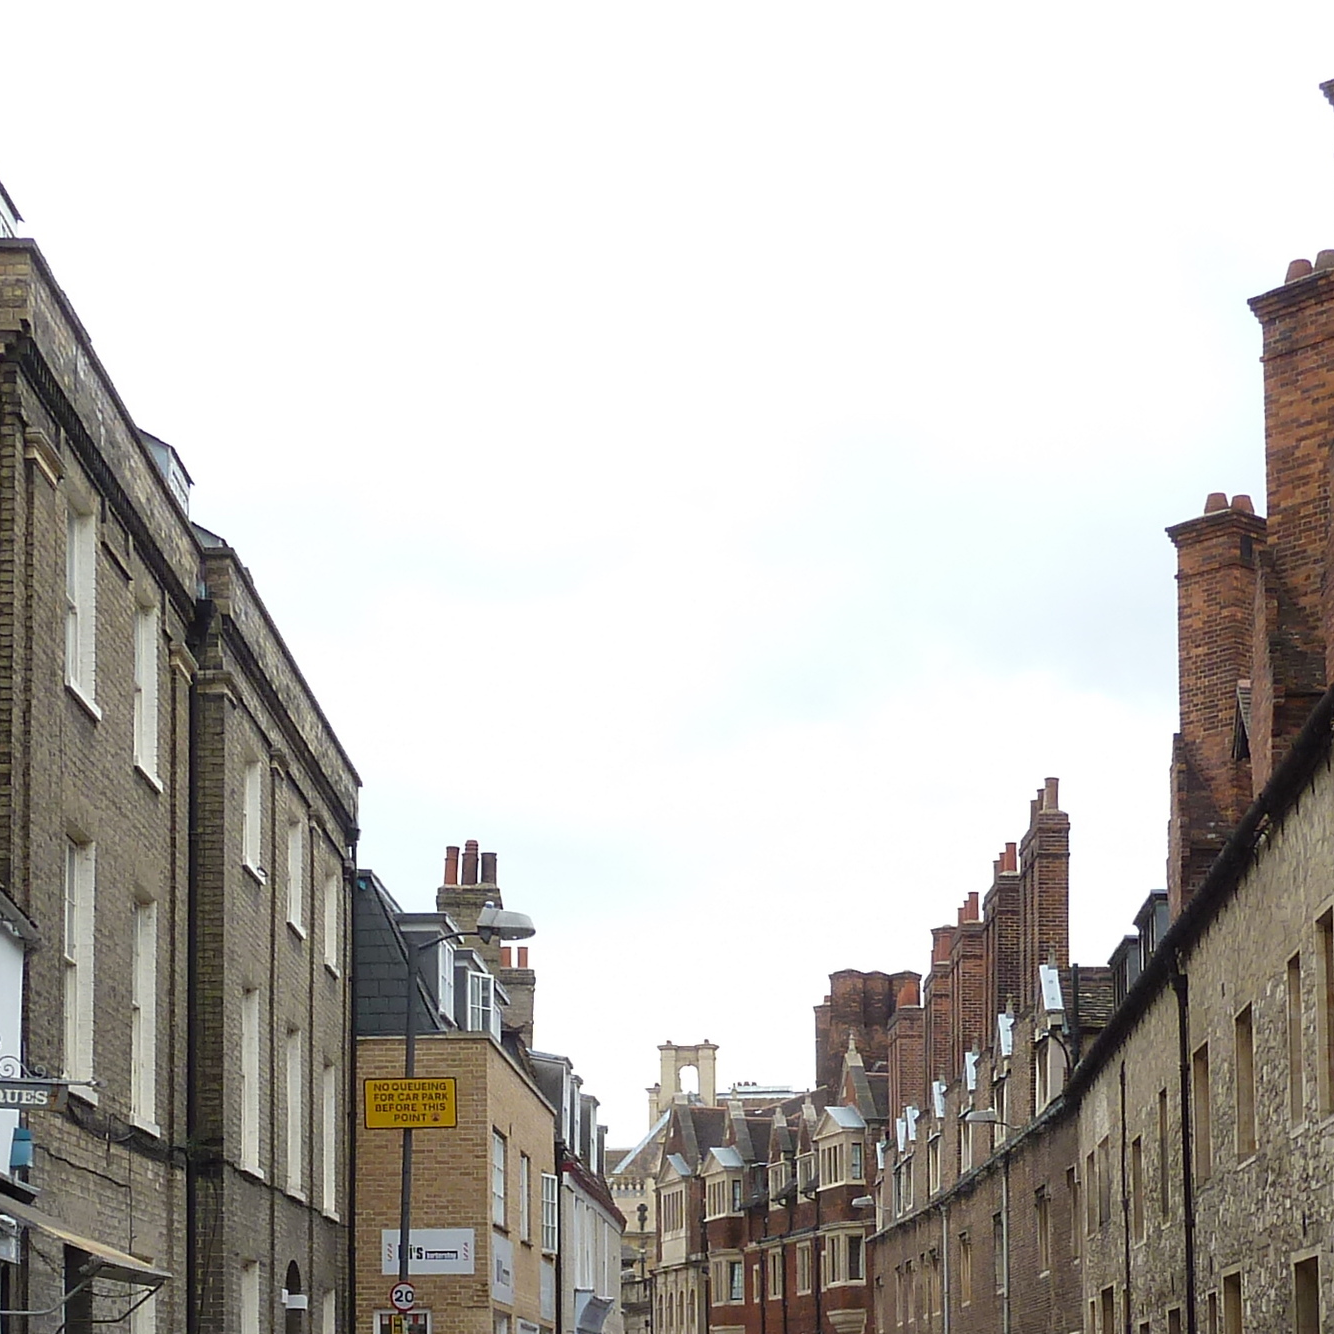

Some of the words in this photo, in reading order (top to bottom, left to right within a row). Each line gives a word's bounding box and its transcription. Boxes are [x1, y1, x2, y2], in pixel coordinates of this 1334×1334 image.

[373, 1083, 390, 1091] NO
[391, 1082, 447, 1091] QUEUEING
[373, 1093, 395, 1102] FOR
[397, 1093, 419, 1101] CAR
[421, 1092, 448, 1101] PARK
[375, 1103, 417, 1112] BEFORE
[422, 1103, 446, 1111] THIS
[393, 1113, 427, 1122] POINT
[394, 1289, 414, 1303] 20
[394, 1317, 402, 1334] H
